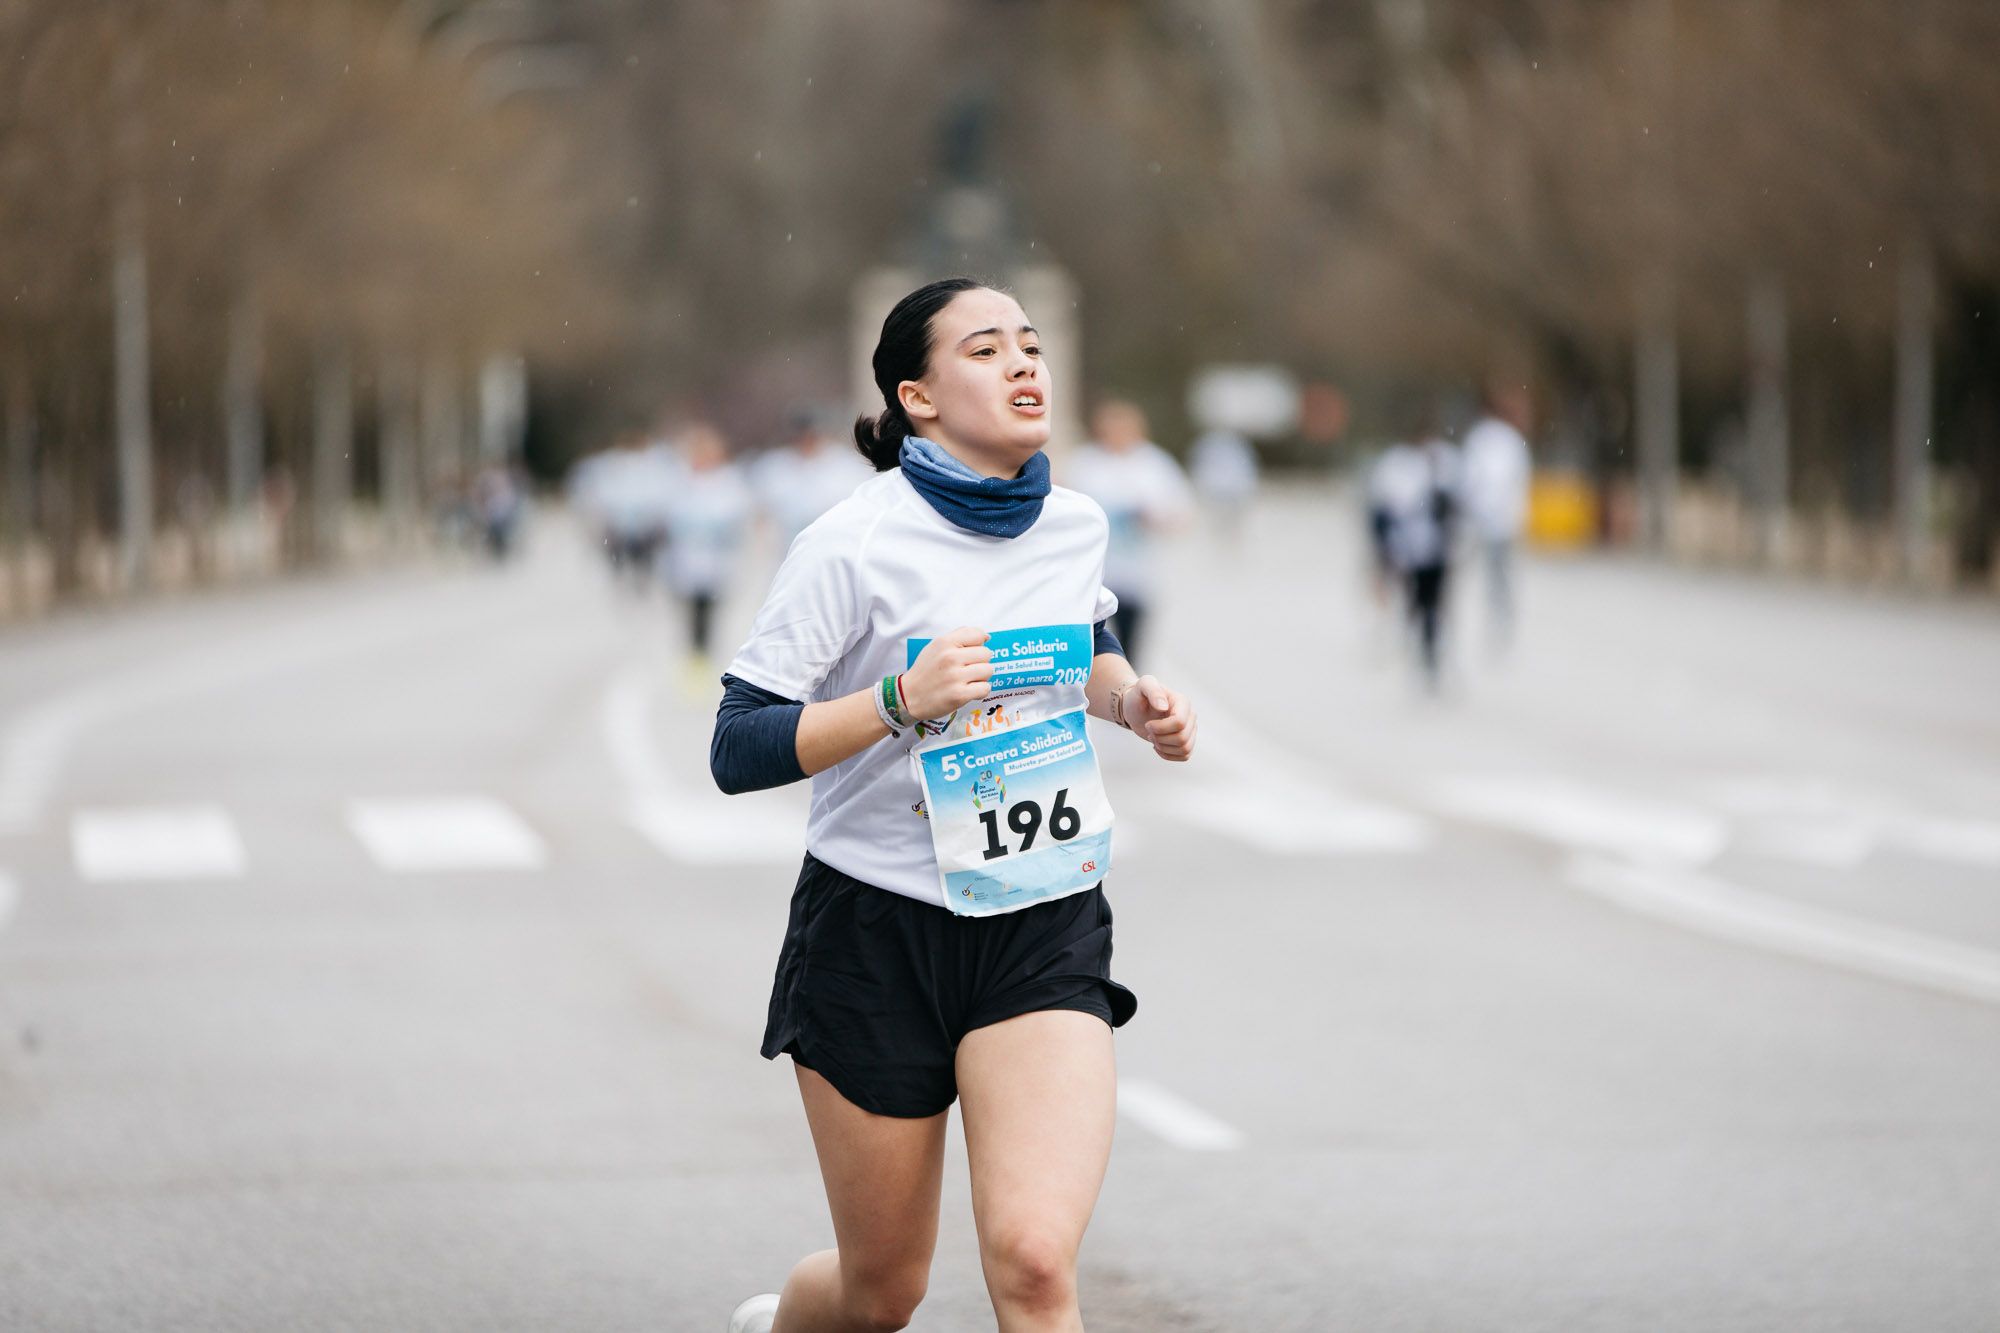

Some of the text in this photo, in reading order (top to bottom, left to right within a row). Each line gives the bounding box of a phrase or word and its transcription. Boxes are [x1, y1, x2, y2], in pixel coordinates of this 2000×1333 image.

[1012, 639, 1068, 656] Solidaria
[1006, 677, 1013, 686] 7
[1014, 676, 1025, 685] de
[1026, 675, 1053, 684] marzo
[1055, 667, 1089, 686] 2026
[964, 748, 1019, 769] Carrera
[1021, 729, 1073, 755] Solidaria
[978, 788, 1081, 861] 196
[1082, 860, 1096, 873] CSL
